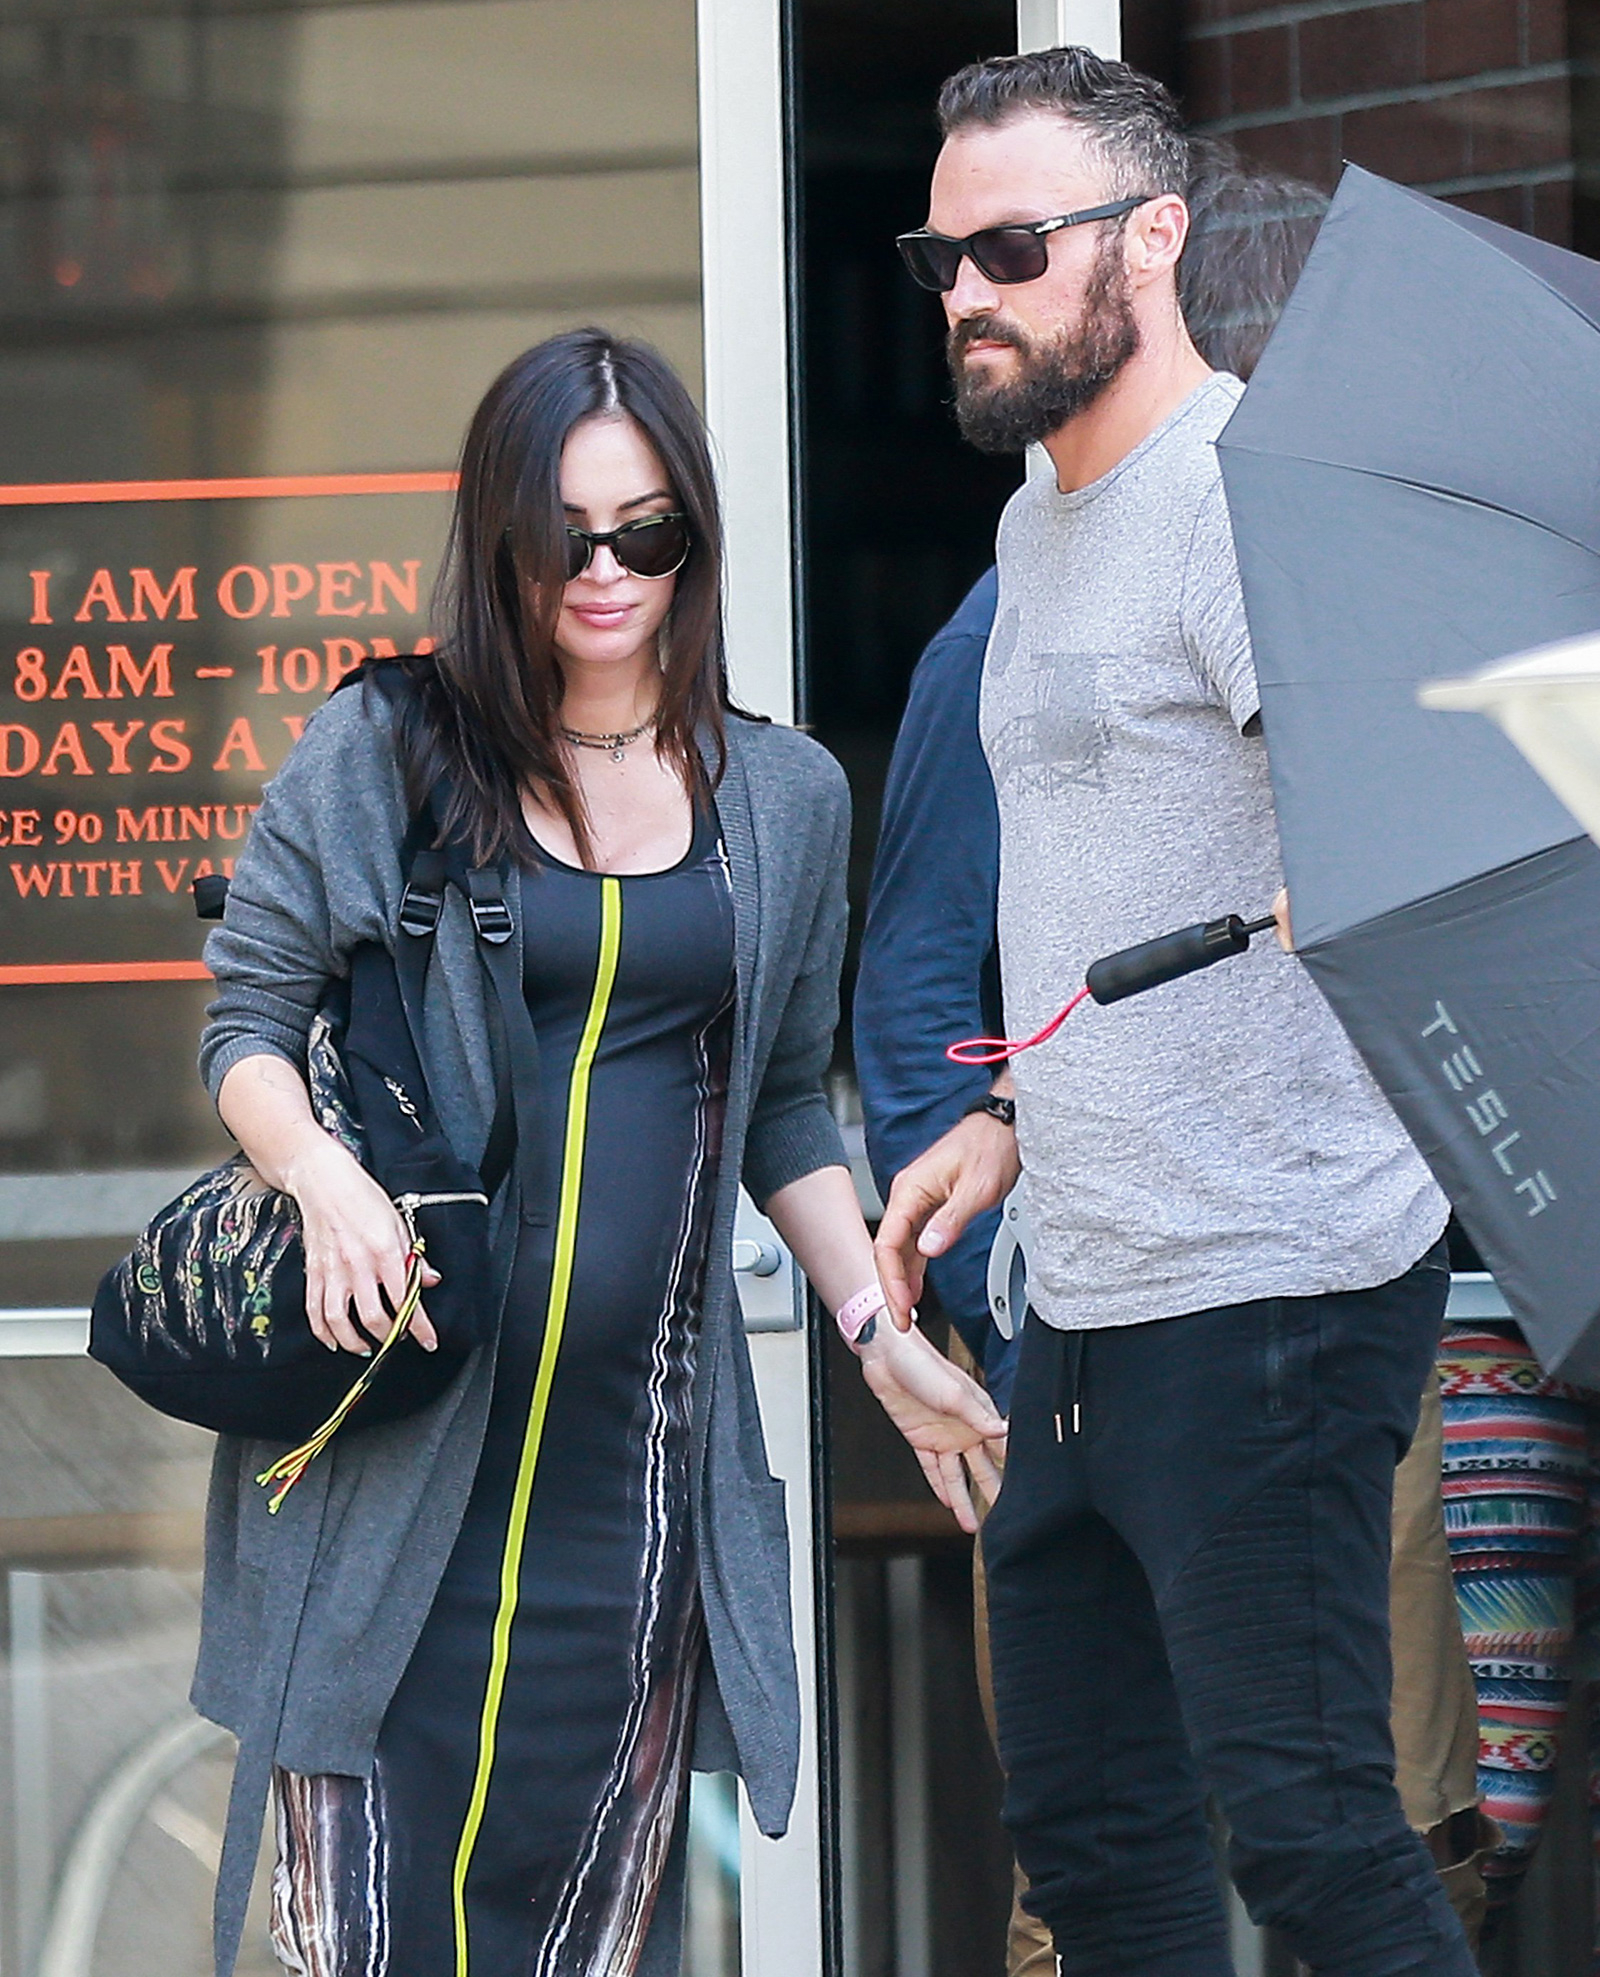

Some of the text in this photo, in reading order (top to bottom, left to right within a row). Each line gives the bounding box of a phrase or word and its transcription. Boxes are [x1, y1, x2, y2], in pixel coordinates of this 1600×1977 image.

[29, 561, 422, 625] I AM OPEN
[14, 643, 175, 702] 8AM
[0, 719, 192, 777] DAYS
[212, 716, 268, 772] A
[54, 809, 103, 845] 90
[116, 804, 259, 843] MINU
[10, 860, 142, 898] WITH
[1421, 1000, 1557, 1217] TESLA
